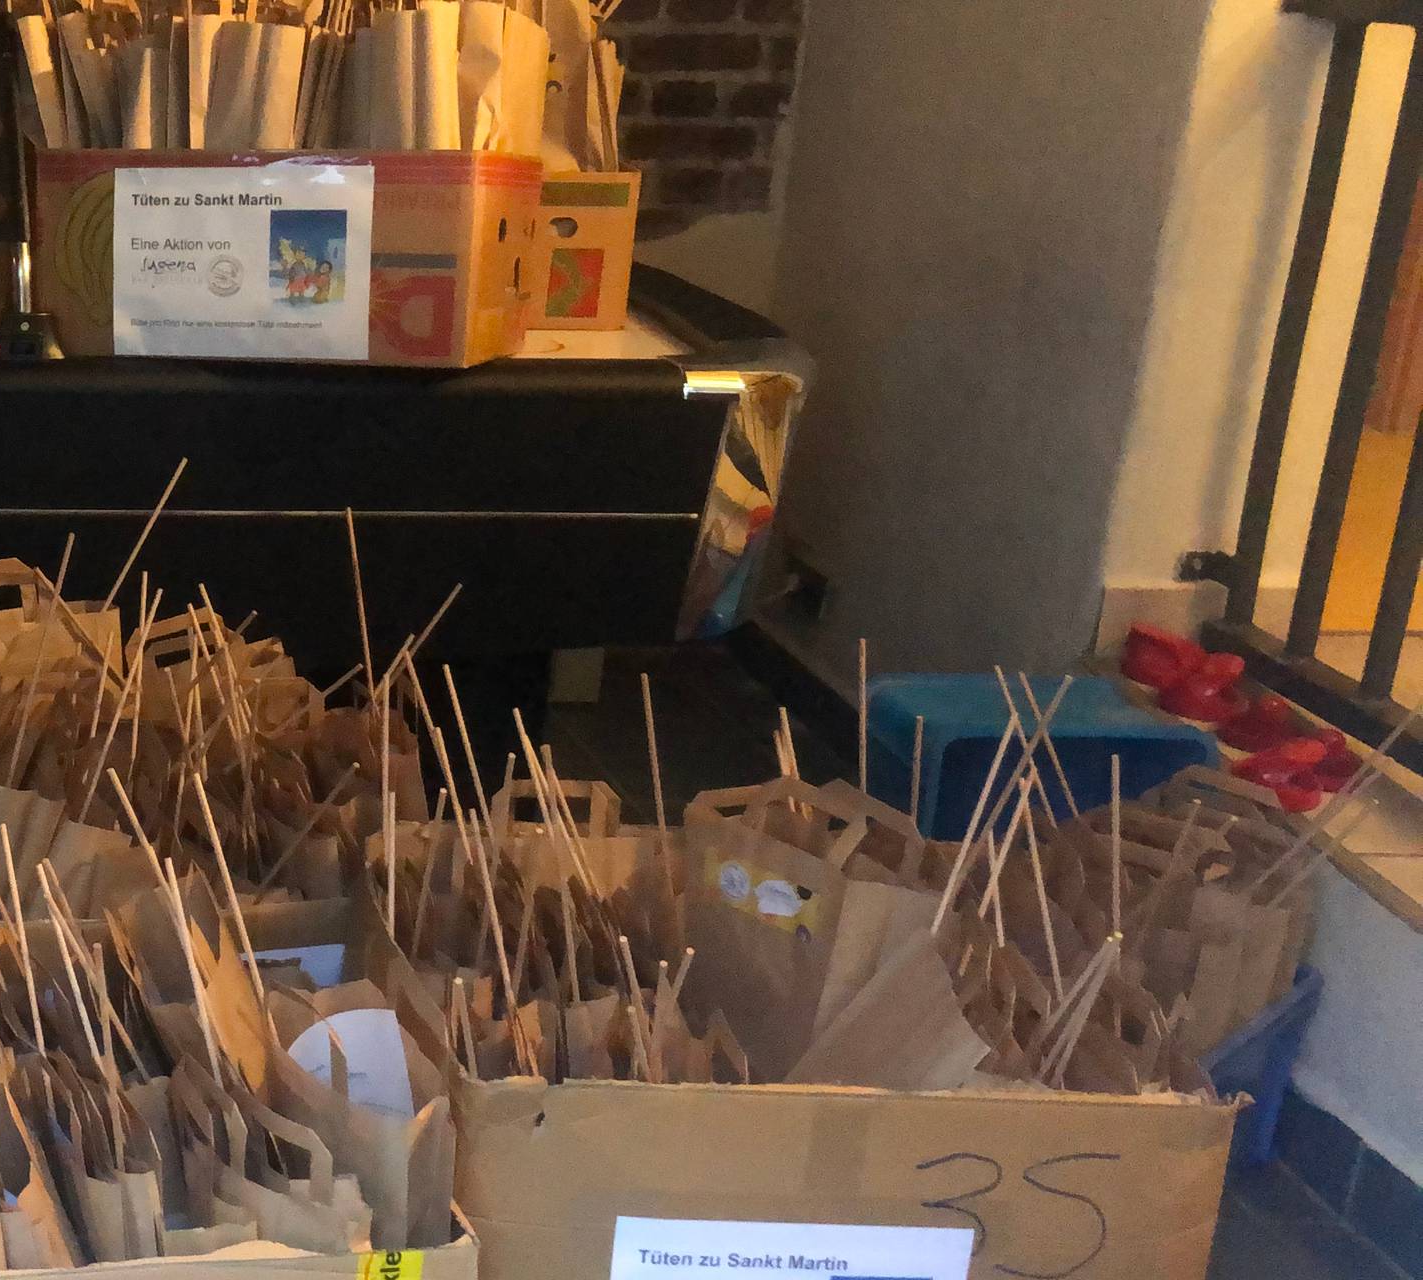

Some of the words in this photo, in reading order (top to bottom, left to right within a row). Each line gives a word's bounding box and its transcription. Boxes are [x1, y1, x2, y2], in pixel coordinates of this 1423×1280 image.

[131, 193, 170, 206] Tüten
[174, 195, 190, 206] zu
[194, 193, 234, 206] Sankt
[238, 193, 282, 206] Martin
[131, 238, 159, 250] Eine
[163, 238, 203, 250] Aktion
[207, 241, 231, 250] von
[638, 1249, 693, 1266] Tüten
[698, 1254, 721, 1267] zu
[727, 1252, 782, 1268] Sankt
[788, 1255, 849, 1271] Martin
